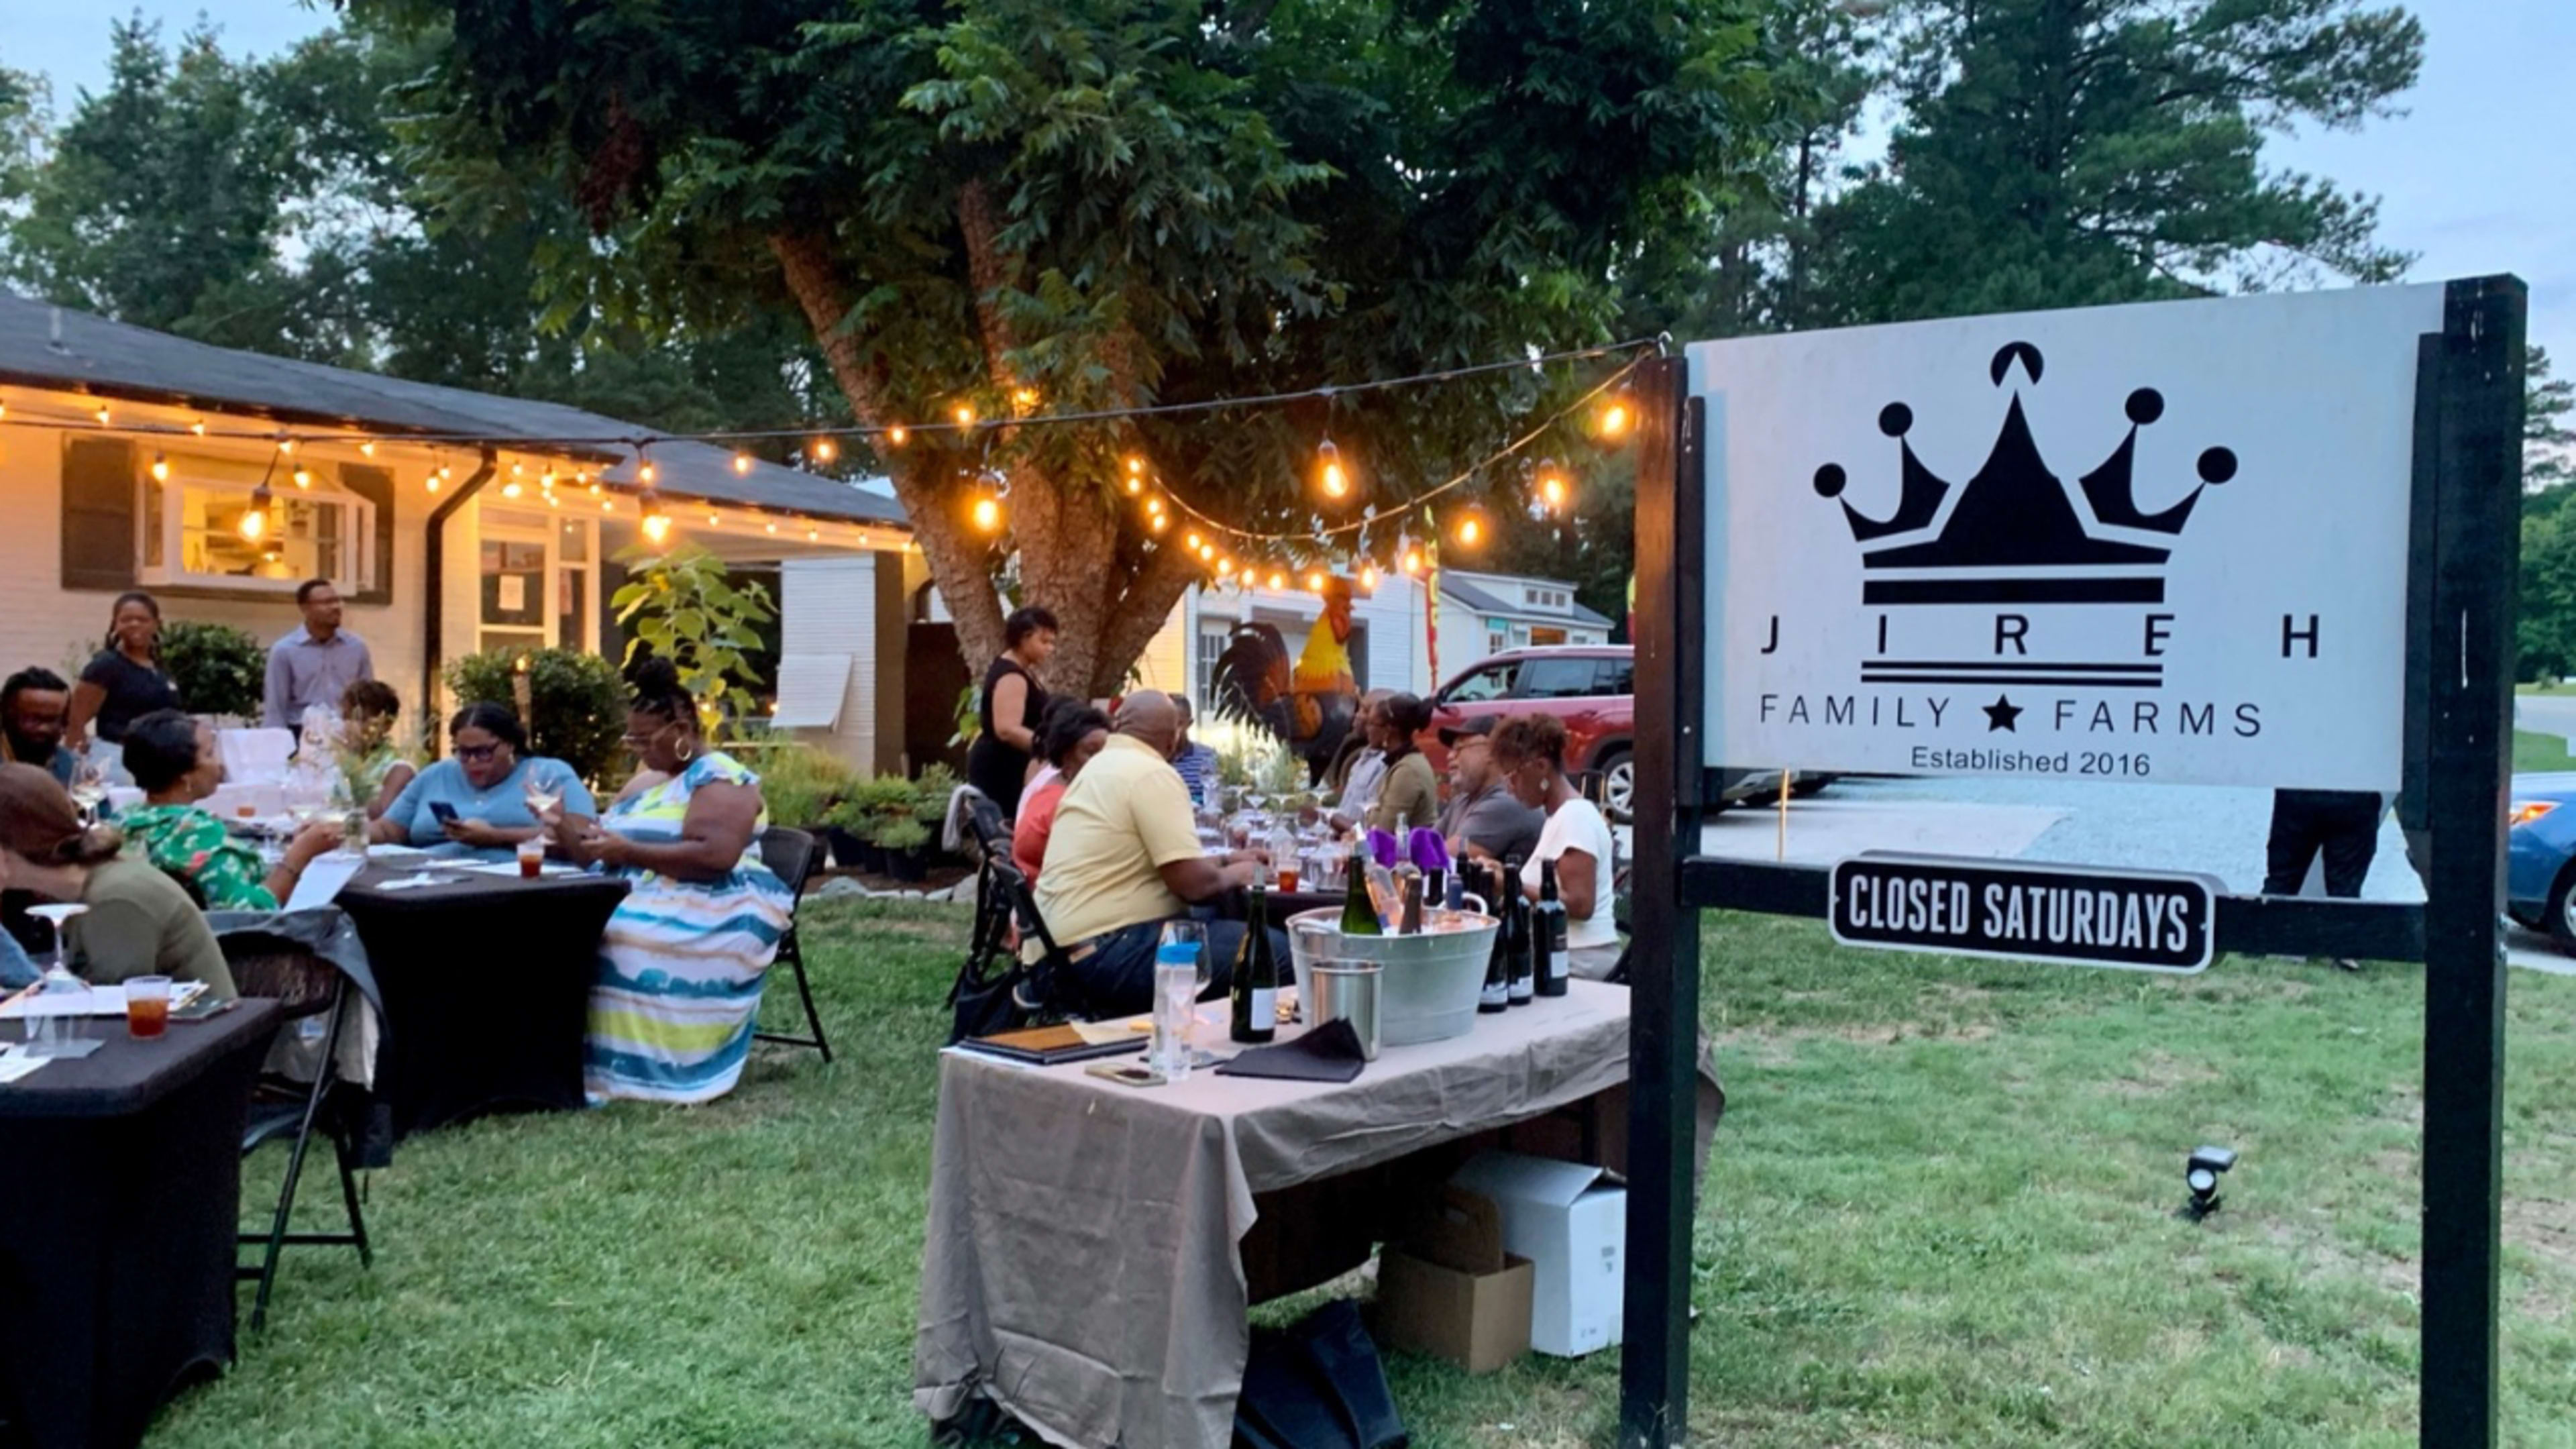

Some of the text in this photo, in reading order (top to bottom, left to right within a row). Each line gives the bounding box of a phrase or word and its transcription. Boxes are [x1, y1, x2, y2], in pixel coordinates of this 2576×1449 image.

[1760, 612, 2320, 659] JIREH
[1760, 693, 2261, 739] FAMILY FARMS
[1911, 745, 2151, 777] Established 2016
[1849, 874, 2189, 953] CLOSED SATURDAYS
